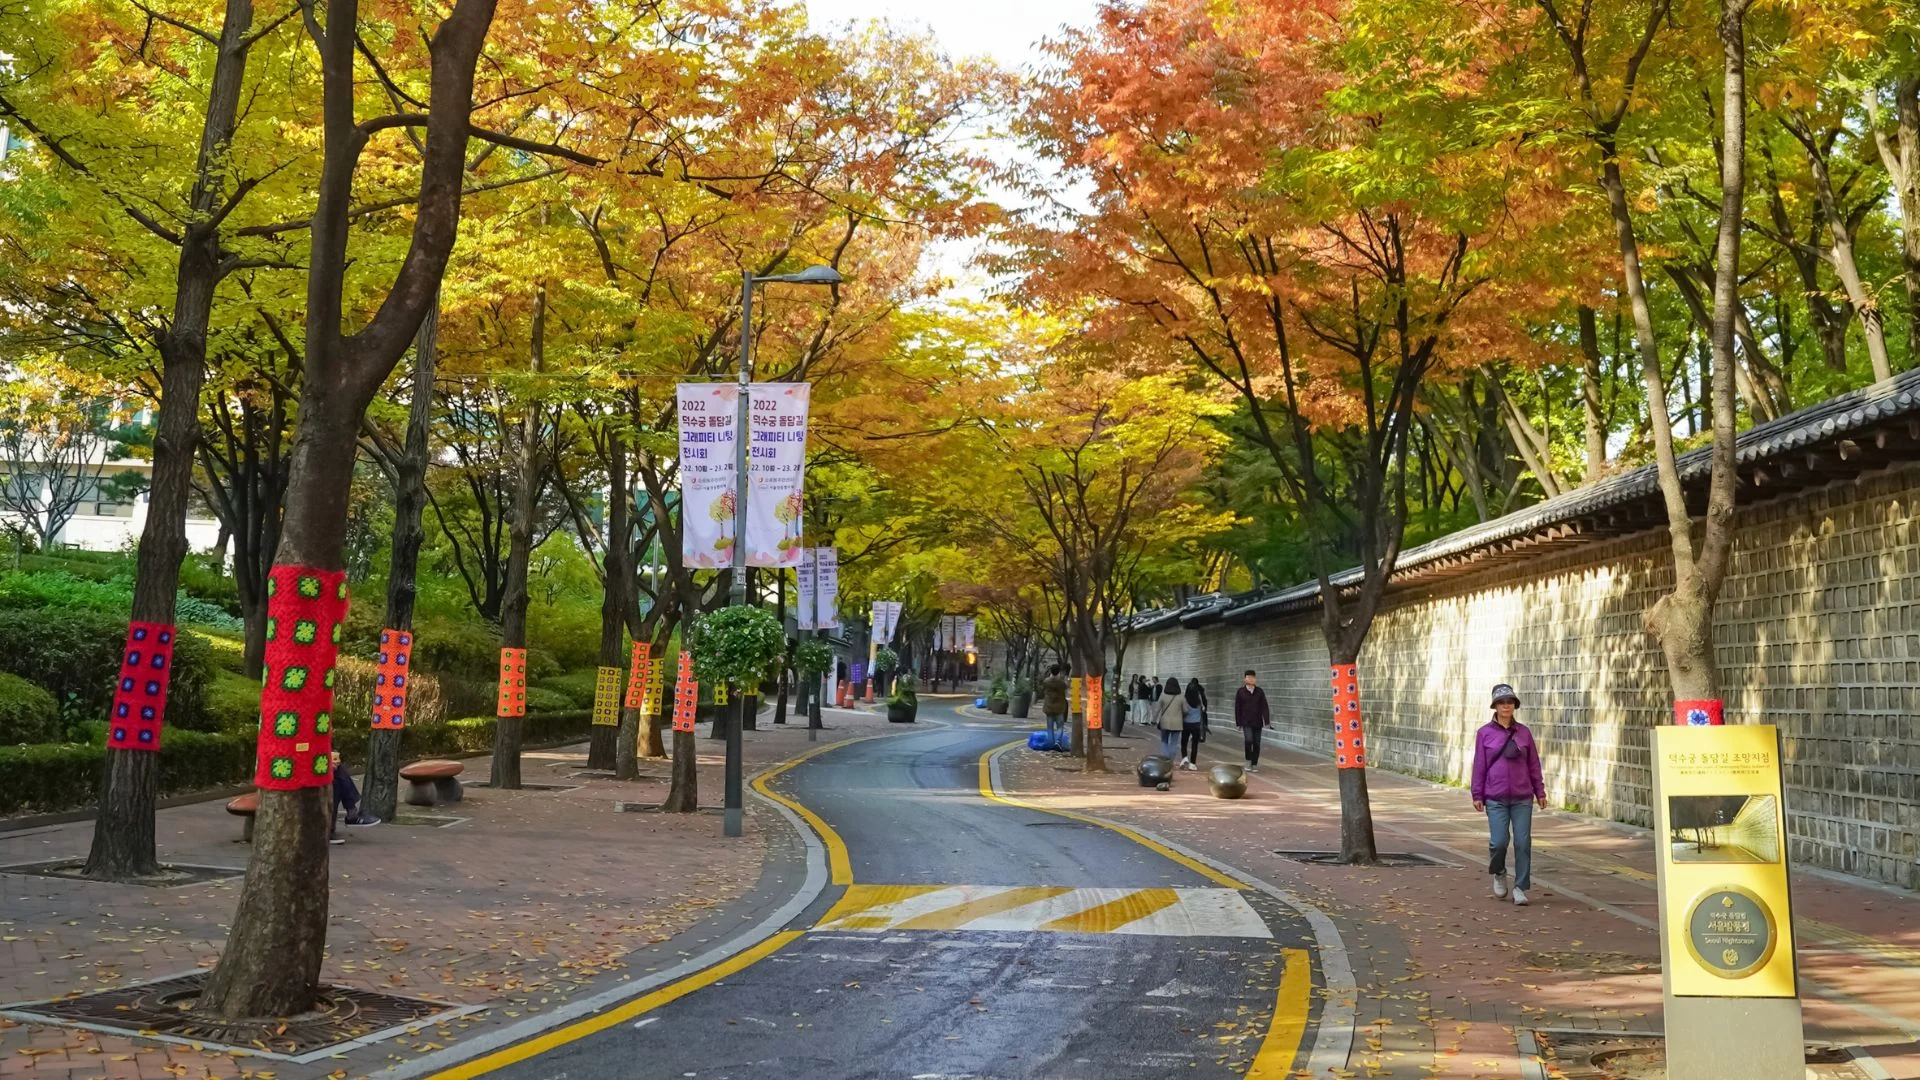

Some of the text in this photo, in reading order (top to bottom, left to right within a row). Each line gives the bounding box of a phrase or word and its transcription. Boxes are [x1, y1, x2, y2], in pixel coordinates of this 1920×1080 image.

[682, 400, 705, 411] 2022
[753, 400, 777, 411] 2022
[682, 415, 731, 427] 덕수궁 돌담길
[753, 415, 803, 427] 덕수궁 돌담길
[683, 430, 733, 443] 그래피티 니팅
[753, 431, 804, 442] 그래피티 니팅
[683, 447, 707, 459] 전시회
[752, 446, 776, 458] 전시회
[1669, 753, 1696, 764] 덕수궁
[1701, 753, 1728, 764] 돌담길
